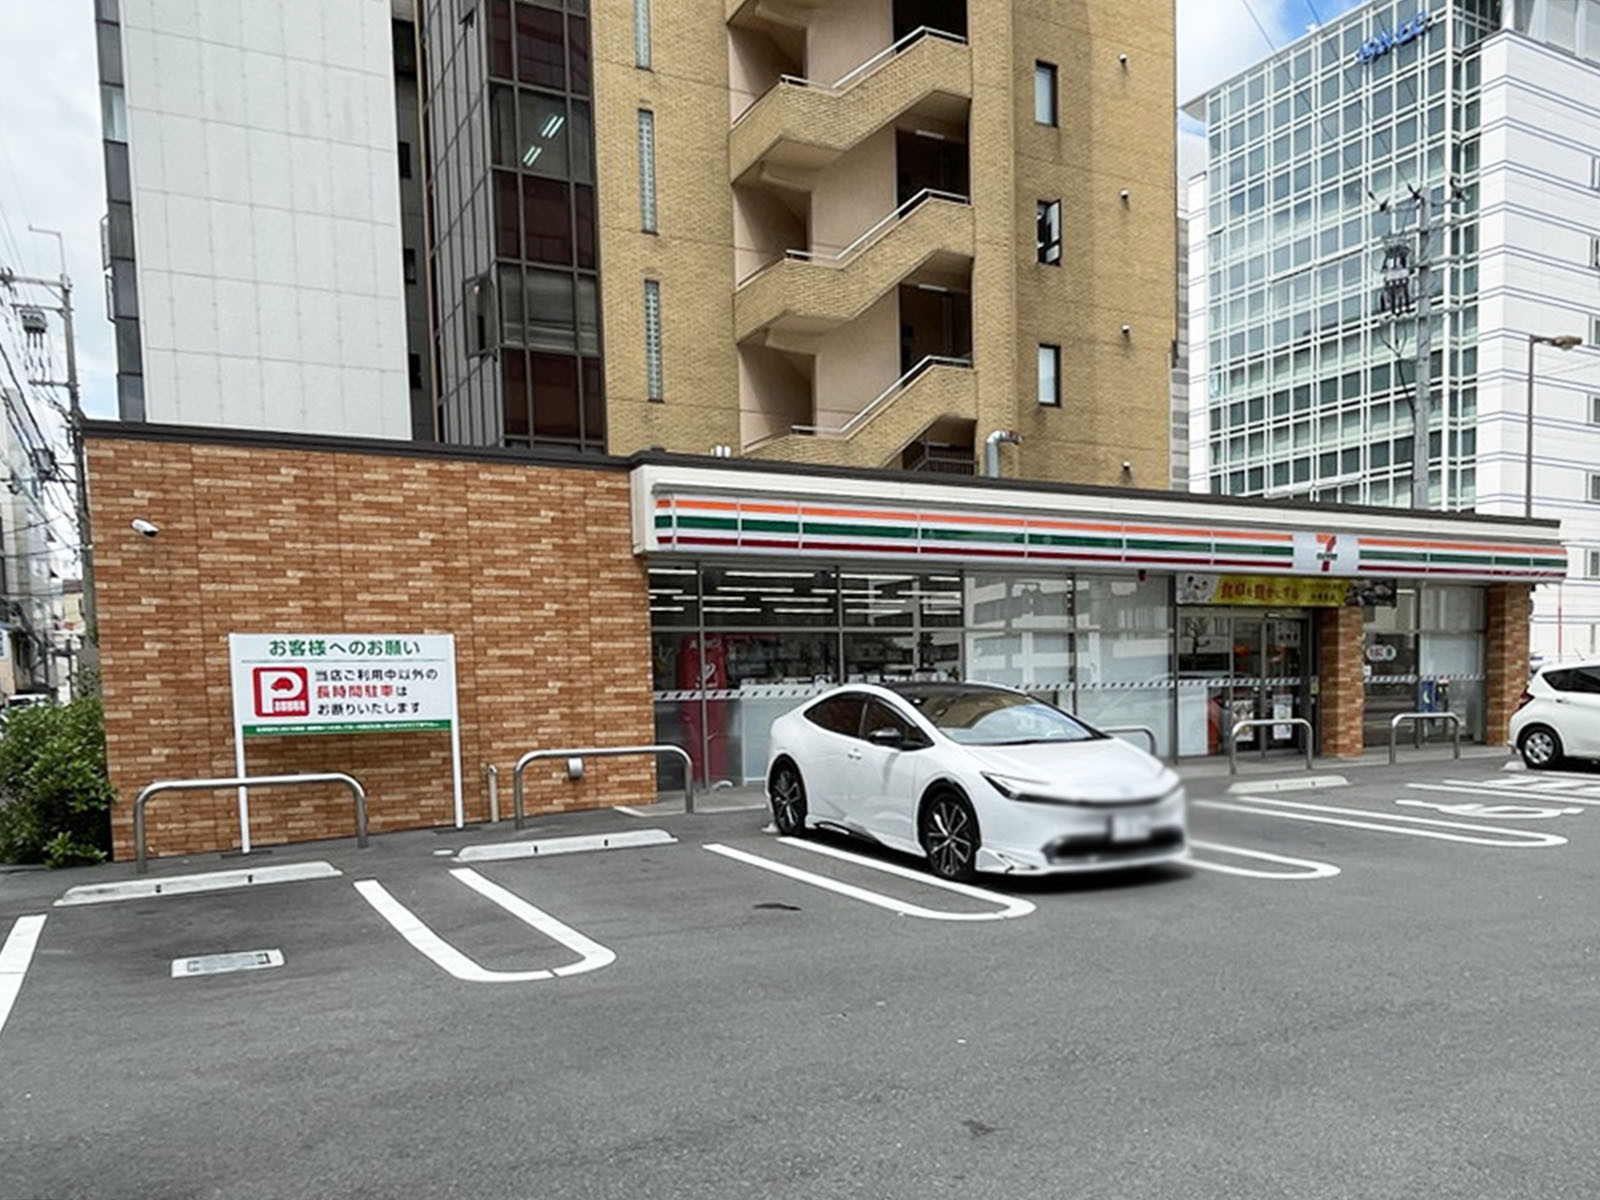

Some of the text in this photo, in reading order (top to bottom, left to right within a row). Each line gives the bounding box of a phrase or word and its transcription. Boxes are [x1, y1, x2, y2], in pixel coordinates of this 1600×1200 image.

[269, 639, 420, 657] お客様へのお願い
[315, 668, 438, 681] 当店ご利用中以外の
[317, 685, 407, 698] 長時間駐車は
[317, 702, 420, 716] お断りいたします
